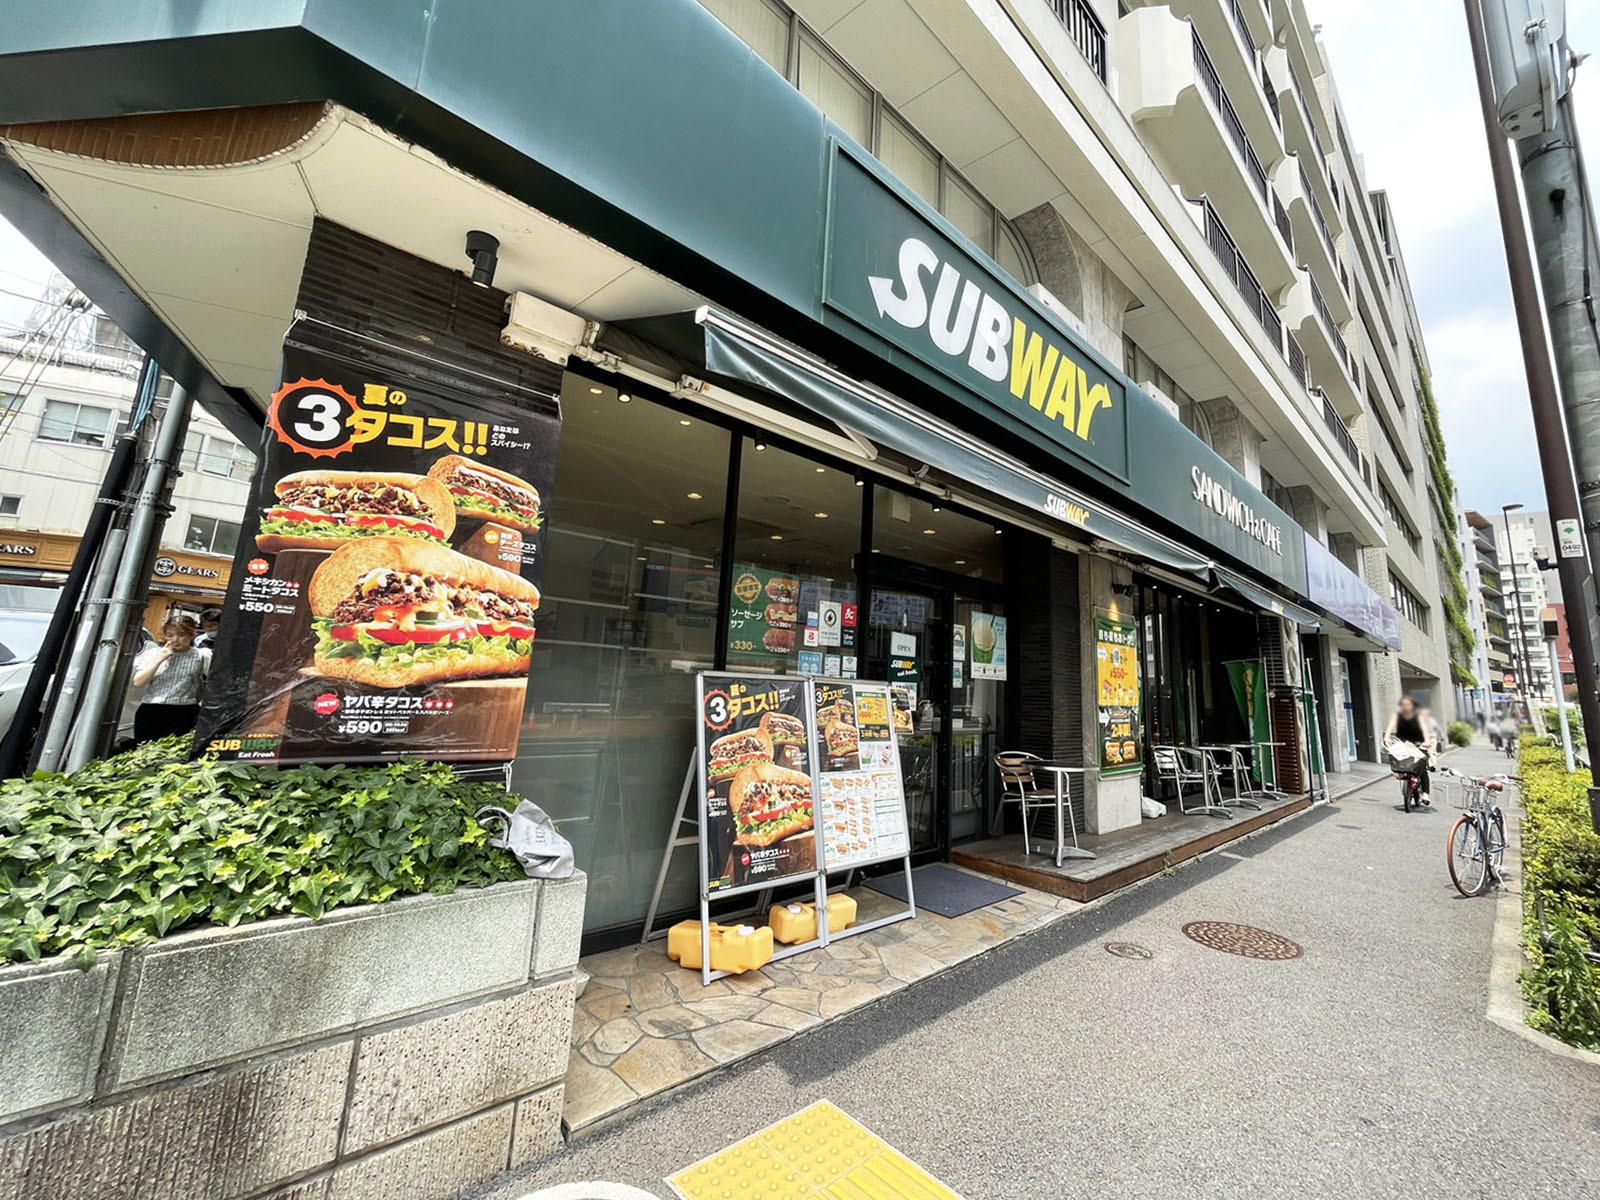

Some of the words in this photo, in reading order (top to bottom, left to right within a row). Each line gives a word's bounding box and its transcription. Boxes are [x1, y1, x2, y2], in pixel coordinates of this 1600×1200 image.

[868, 237, 1112, 442] SUBWAY
[363, 383, 407, 407] 夏の
[296, 393, 341, 442] 3
[345, 409, 489, 456] タコス!!
[1044, 493, 1090, 526] SUBWAY
[1191, 465, 1254, 537] SANDWICH
[177, 565, 219, 578] GEARS
[244, 576, 287, 587] メキシカン
[242, 584, 299, 597] ミートタコス
[238, 601, 274, 613] ¥550
[343, 694, 423, 710] ヤバ辛タコス
[710, 697, 727, 723] 3
[727, 690, 780, 719] タコス!!
[338, 720, 382, 734] ¥590
[205, 739, 283, 752] SUBWAY
